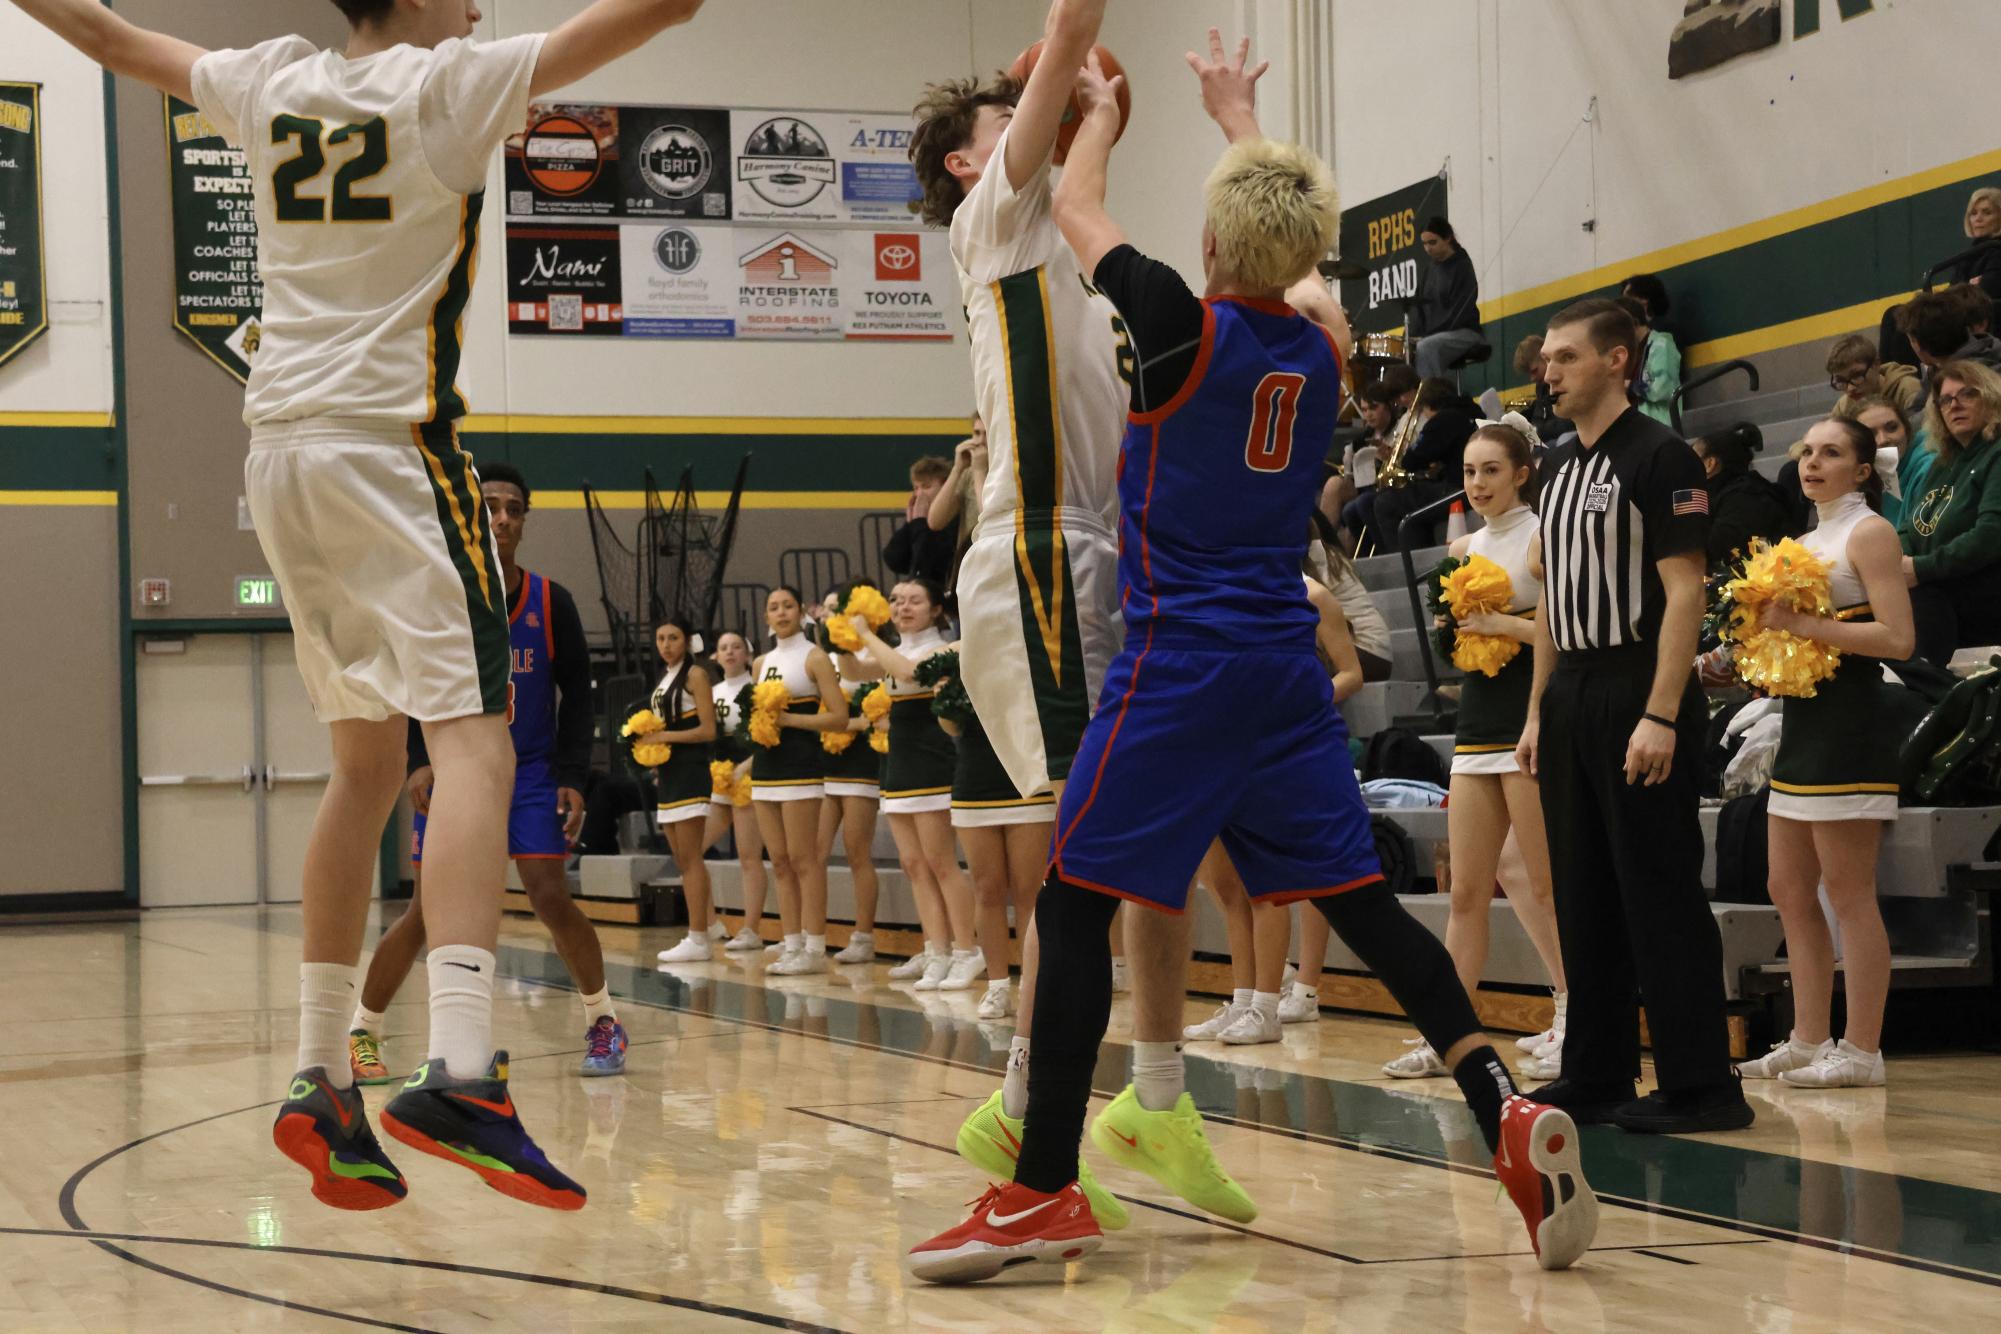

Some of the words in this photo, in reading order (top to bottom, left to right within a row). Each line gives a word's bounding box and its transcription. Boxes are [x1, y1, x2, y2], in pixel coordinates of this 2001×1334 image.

[183, 149, 246, 167] SPORTS
[270, 113, 393, 224] 22
[547, 163, 575, 171] PIZZA
[661, 158, 698, 173] GRIT
[743, 162, 792, 174] Harmony
[793, 162, 831, 174] Canine
[193, 176, 253, 194] EXPECT
[216, 200, 234, 210] SO
[236, 200, 255, 211] PLE
[228, 211, 246, 222] LET
[207, 221, 257, 233] PLAYERS
[1367, 208, 1416, 259] RPHS
[229, 236, 247, 246] LET
[194, 246, 254, 258] COACHES
[230, 261, 248, 271] LET
[519, 244, 608, 286] Nami
[188, 271, 248, 282] OFFICIALS
[1368, 258, 1418, 310] BAND
[231, 286, 249, 296] LET
[739, 286, 838, 297] INTERSTATE
[179, 296, 252, 307] SPECTATORS
[739, 297, 840, 308] ROOFING
[864, 292, 933, 305] TOYOTA
[869, 311, 906, 319] PROUDLY
[907, 311, 943, 319] SUPPORT
[904, 322, 947, 330] ATHLETICS
[1245, 371, 1307, 473] 0
[239, 580, 275, 604] EXIT
[513, 648, 534, 673] LE
